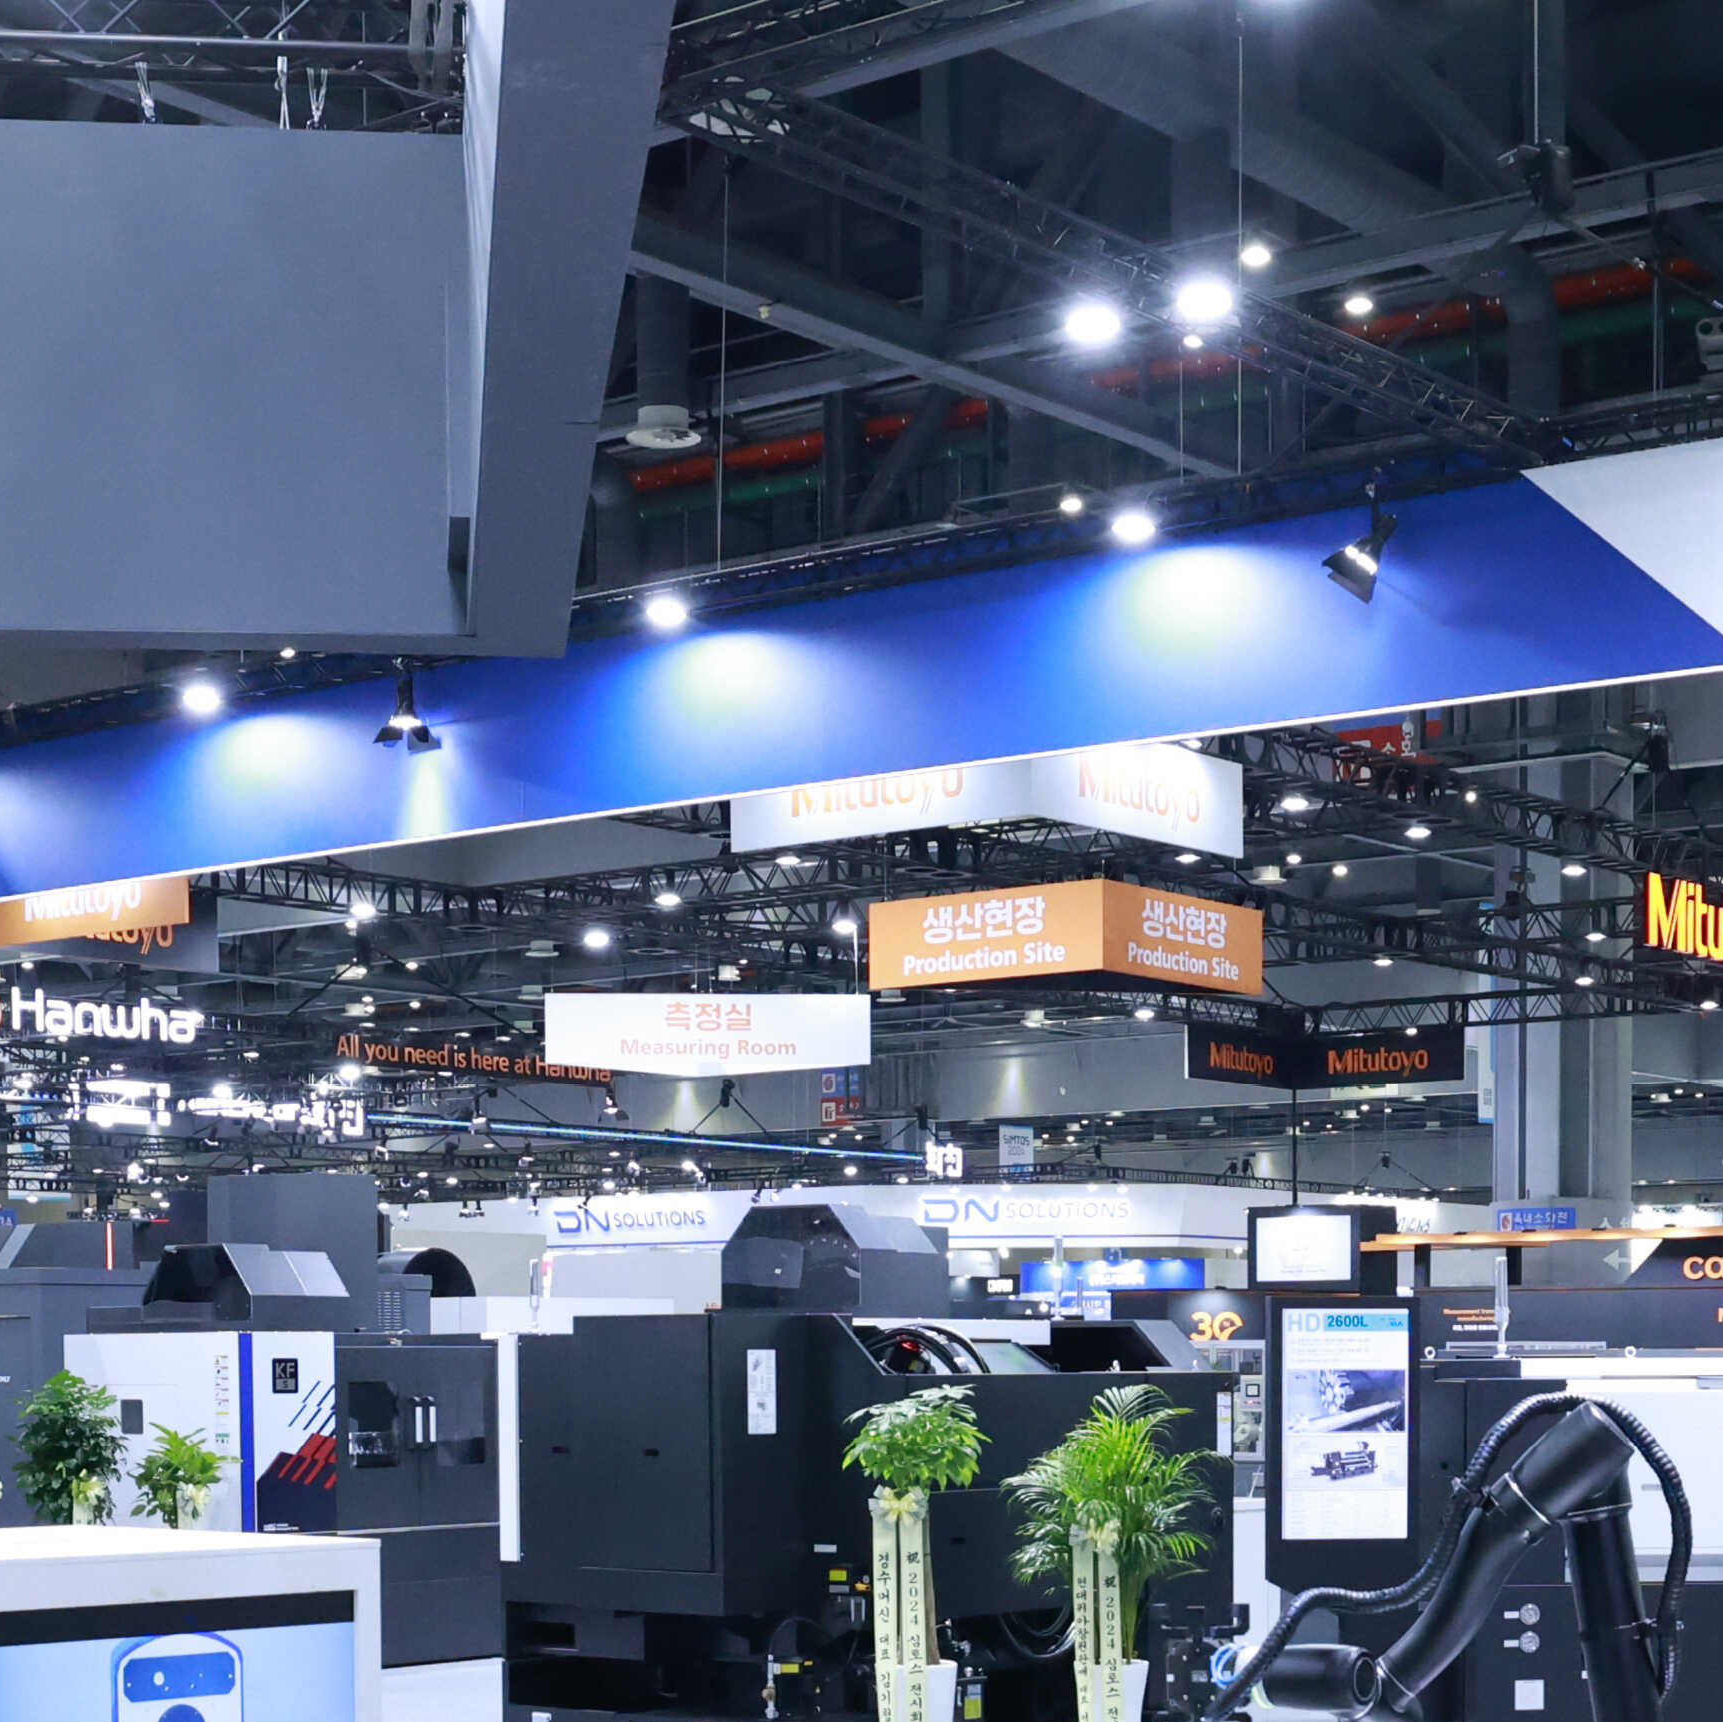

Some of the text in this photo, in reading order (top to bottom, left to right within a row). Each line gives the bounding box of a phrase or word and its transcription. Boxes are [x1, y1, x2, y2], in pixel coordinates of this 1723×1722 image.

[922, 896, 1046, 944] 생산현장
[1141, 898, 1227, 950] 생산현장
[902, 940, 1066, 977] Production Site
[1126, 941, 1240, 981] Production Site
[11, 986, 198, 1044] Hanwha
[665, 1001, 753, 1034] 측정실
[336, 1035, 359, 1058] All
[364, 1042, 399, 1064] you
[403, 1046, 449, 1067] need
[454, 1045, 466, 1068] is
[471, 1047, 509, 1073] here
[514, 1055, 531, 1075] at
[619, 1038, 797, 1060] Measuring Room
[1209, 1041, 1274, 1080] Mitutoyo
[1327, 1047, 1429, 1078] Mitutoyo
[555, 1209, 706, 1234] DN SOLUTIONS
[923, 1198, 1129, 1223] DN SOLUTIONS
[1327, 1315, 1369, 1328] 2600L
[275, 1362, 295, 1378] KF
[909, 1573, 919, 1625] 2024
[1105, 1597, 1116, 1650] 2024
